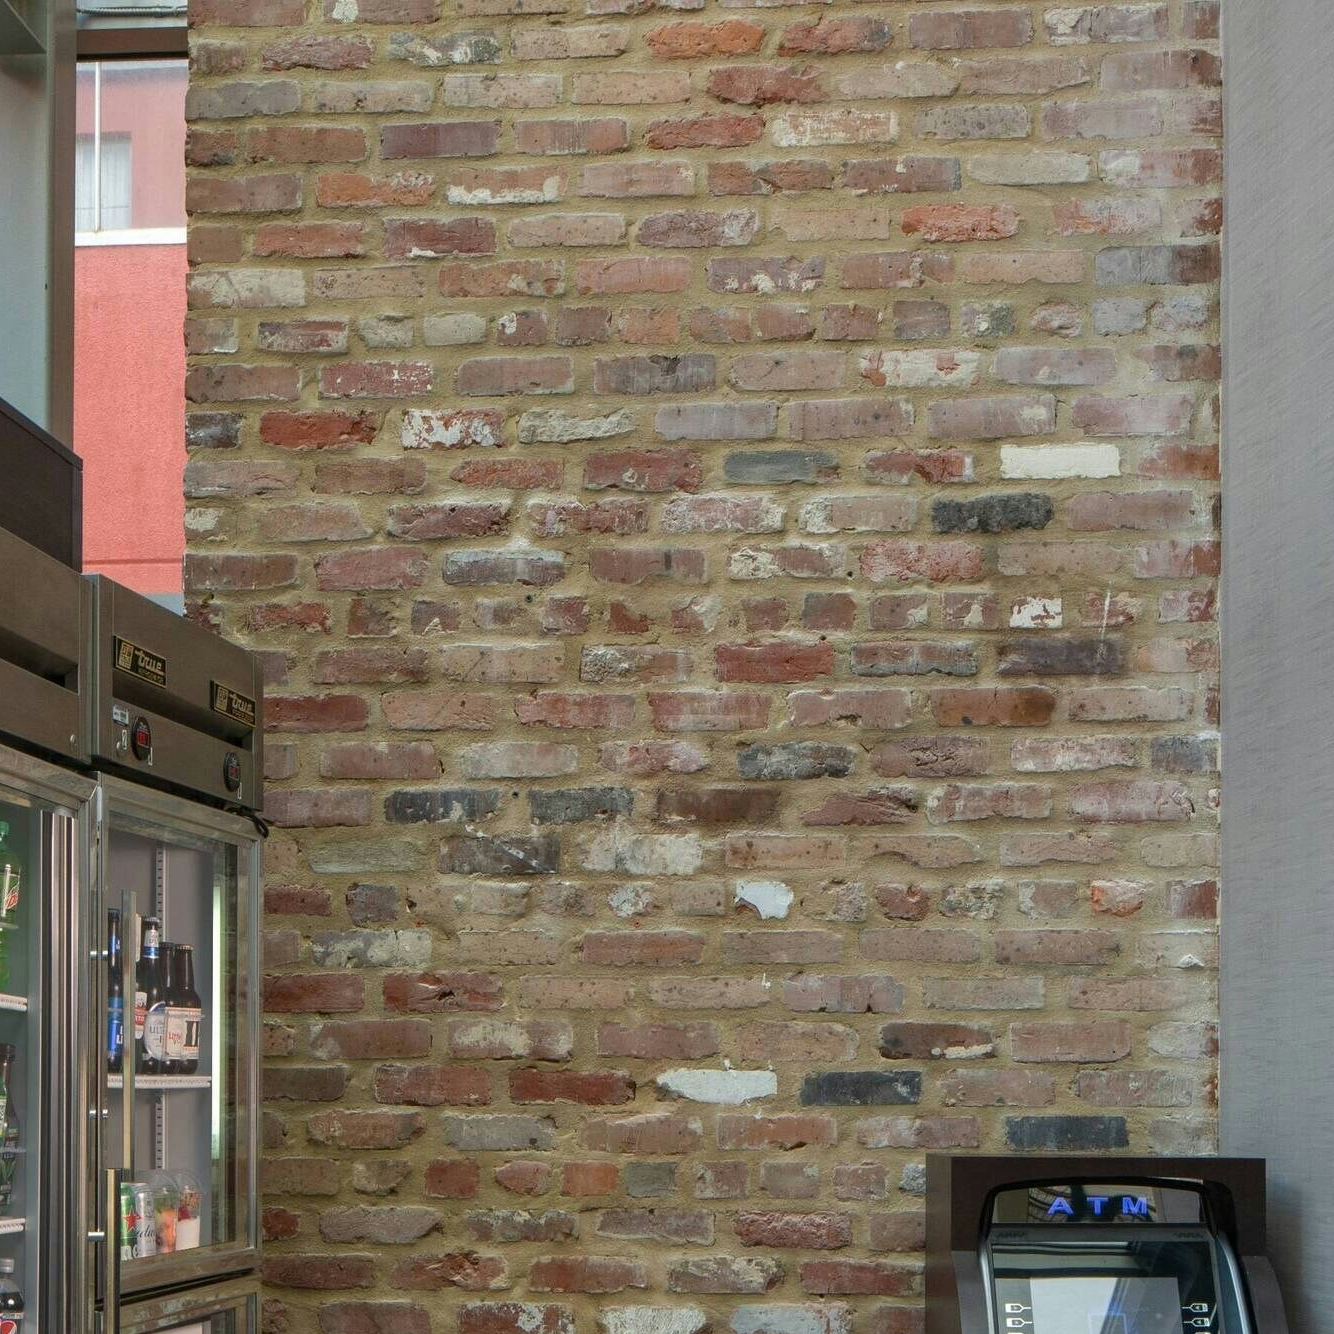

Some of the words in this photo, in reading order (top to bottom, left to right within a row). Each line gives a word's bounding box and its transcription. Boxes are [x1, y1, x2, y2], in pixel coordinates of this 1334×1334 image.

[134, 649, 165, 676] true
[229, 693, 255, 717] true
[1048, 1196, 1149, 1216] ATM
